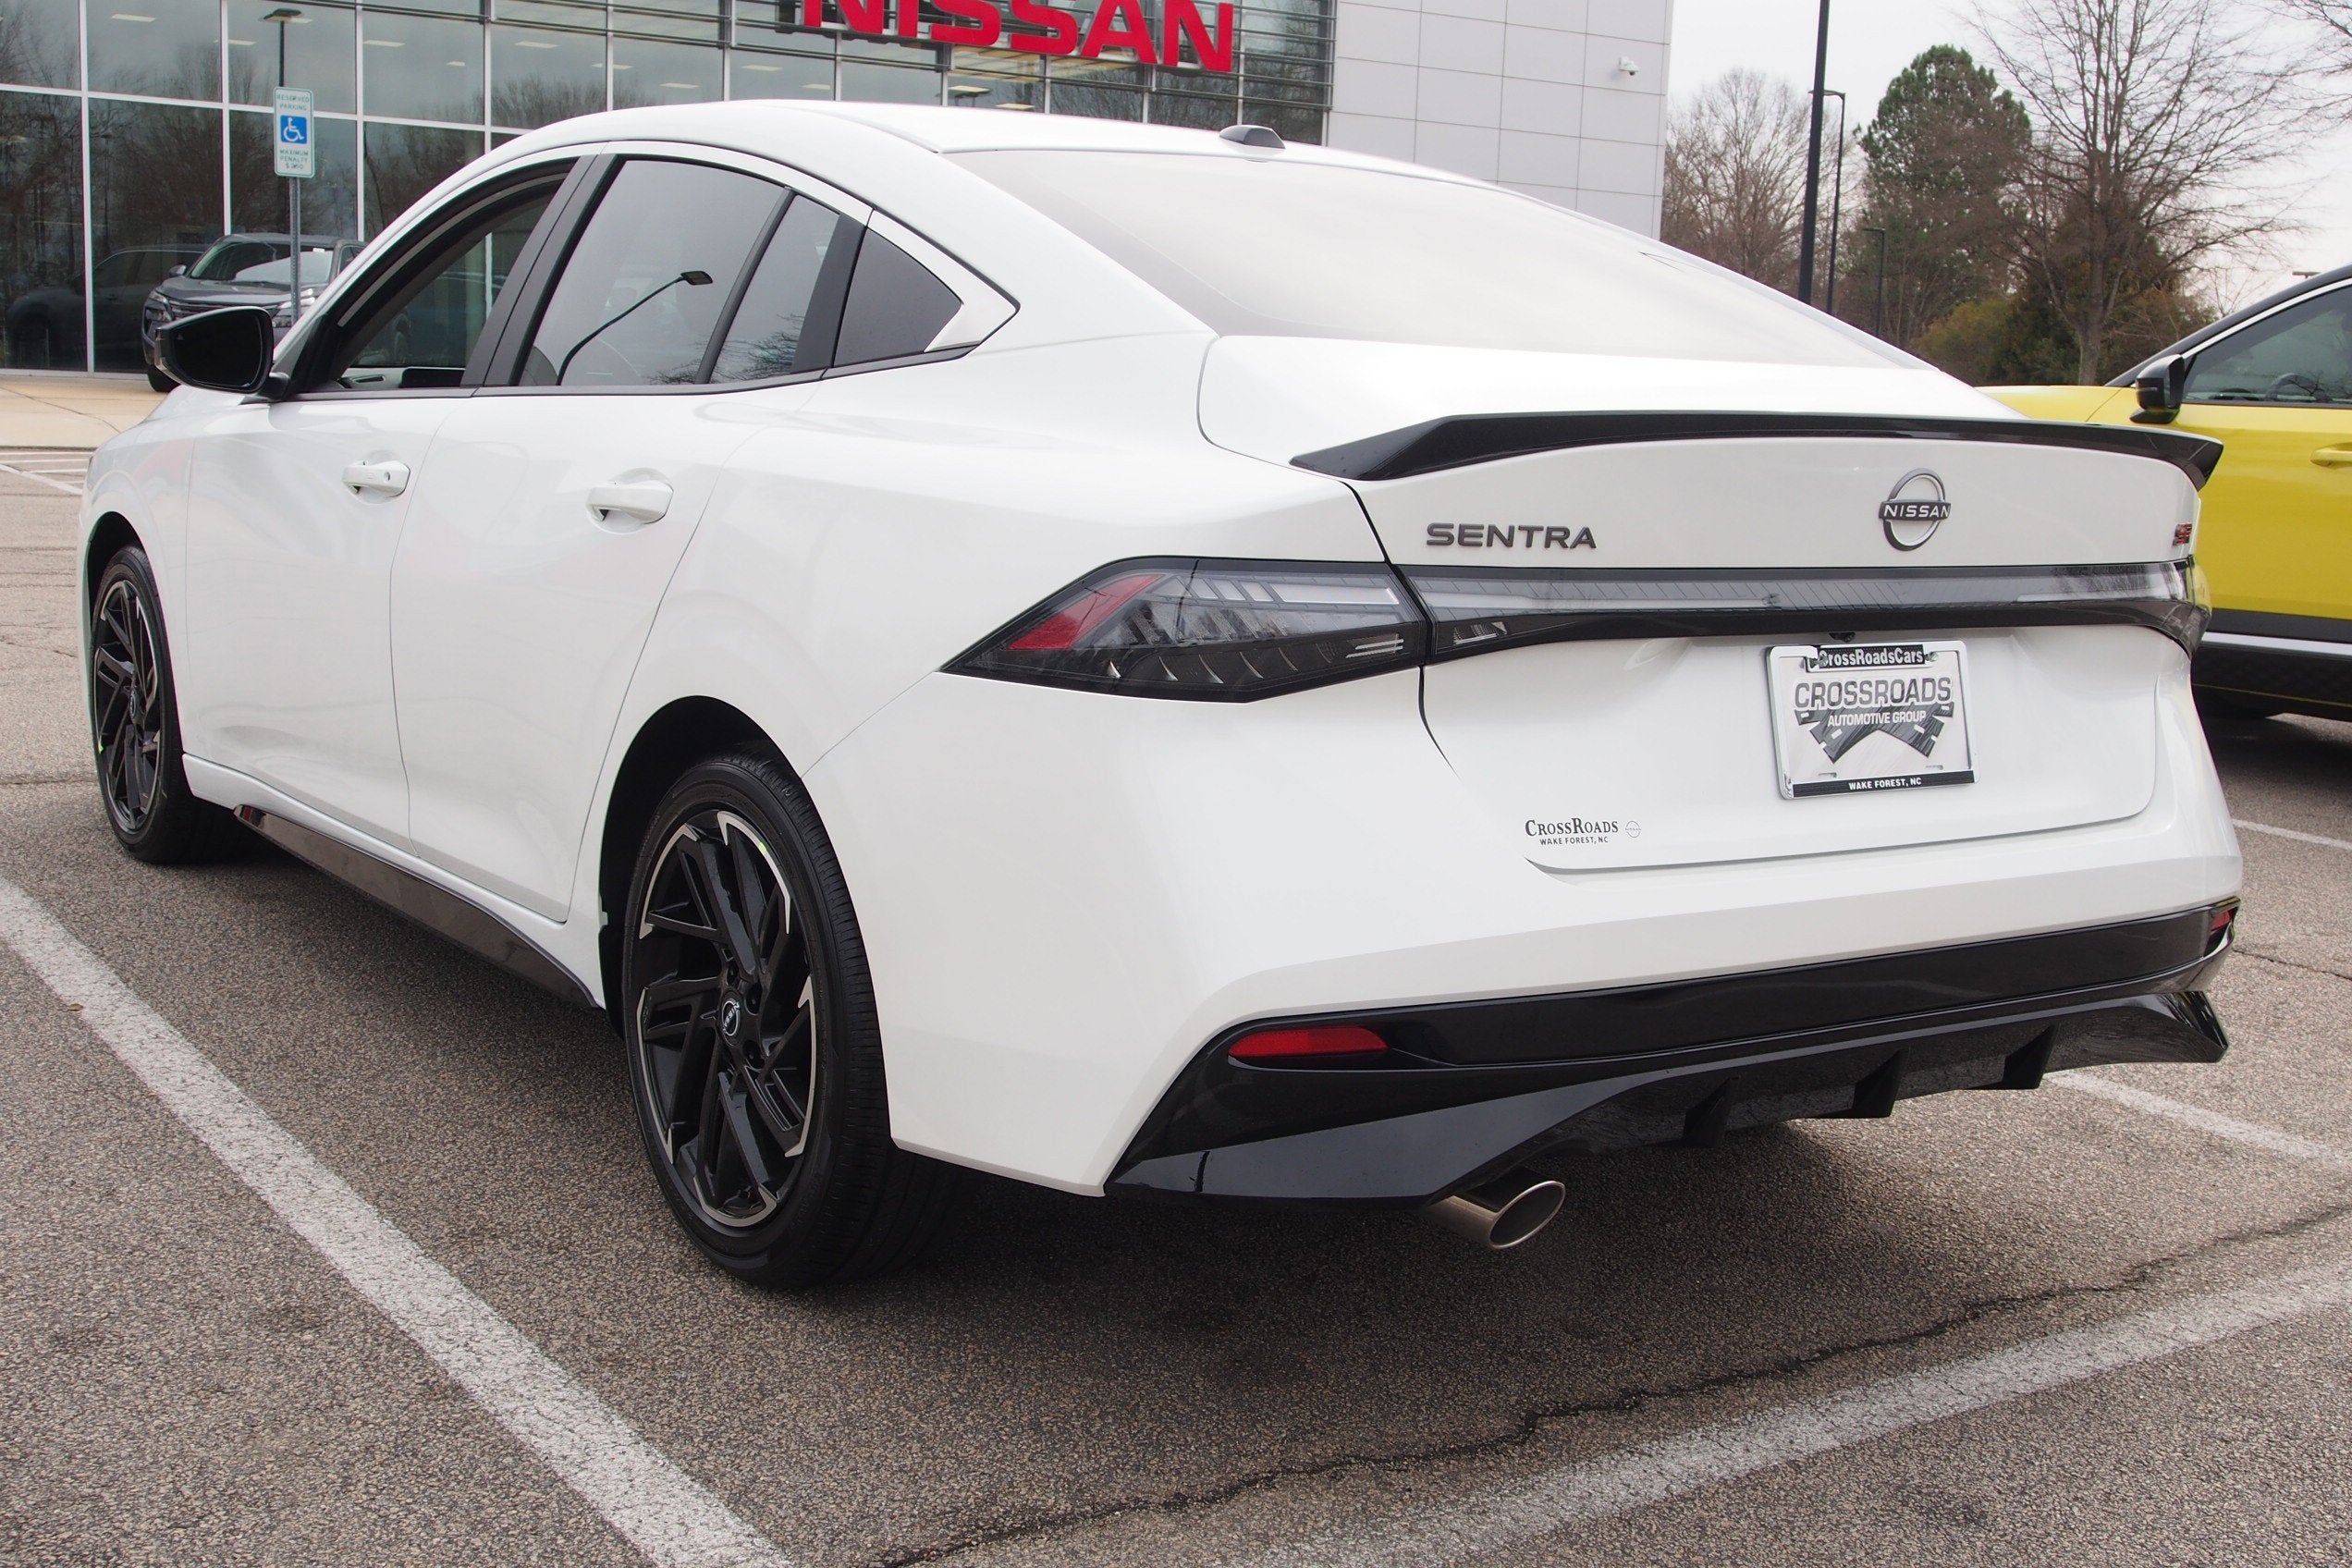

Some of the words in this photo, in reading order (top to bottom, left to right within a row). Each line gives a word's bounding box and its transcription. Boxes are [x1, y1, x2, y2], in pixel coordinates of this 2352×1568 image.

[277, 94, 310, 103] RESERVED
[280, 103, 307, 111] PARKING
[1883, 504, 1950, 518] NISSAN
[1427, 522, 1597, 549] SENTRA
[1795, 677, 1952, 708] CROSSROADS
[1827, 713, 1891, 727] AUTOMOTIVE
[1893, 710, 1927, 723] GROUP
[1849, 780, 1873, 790] WAKE
[1874, 778, 1909, 789] FOREST,
[1909, 777, 1922, 786] NC
[1539, 838, 1562, 846] WAKE
[1564, 836, 1597, 844] FOREST,
